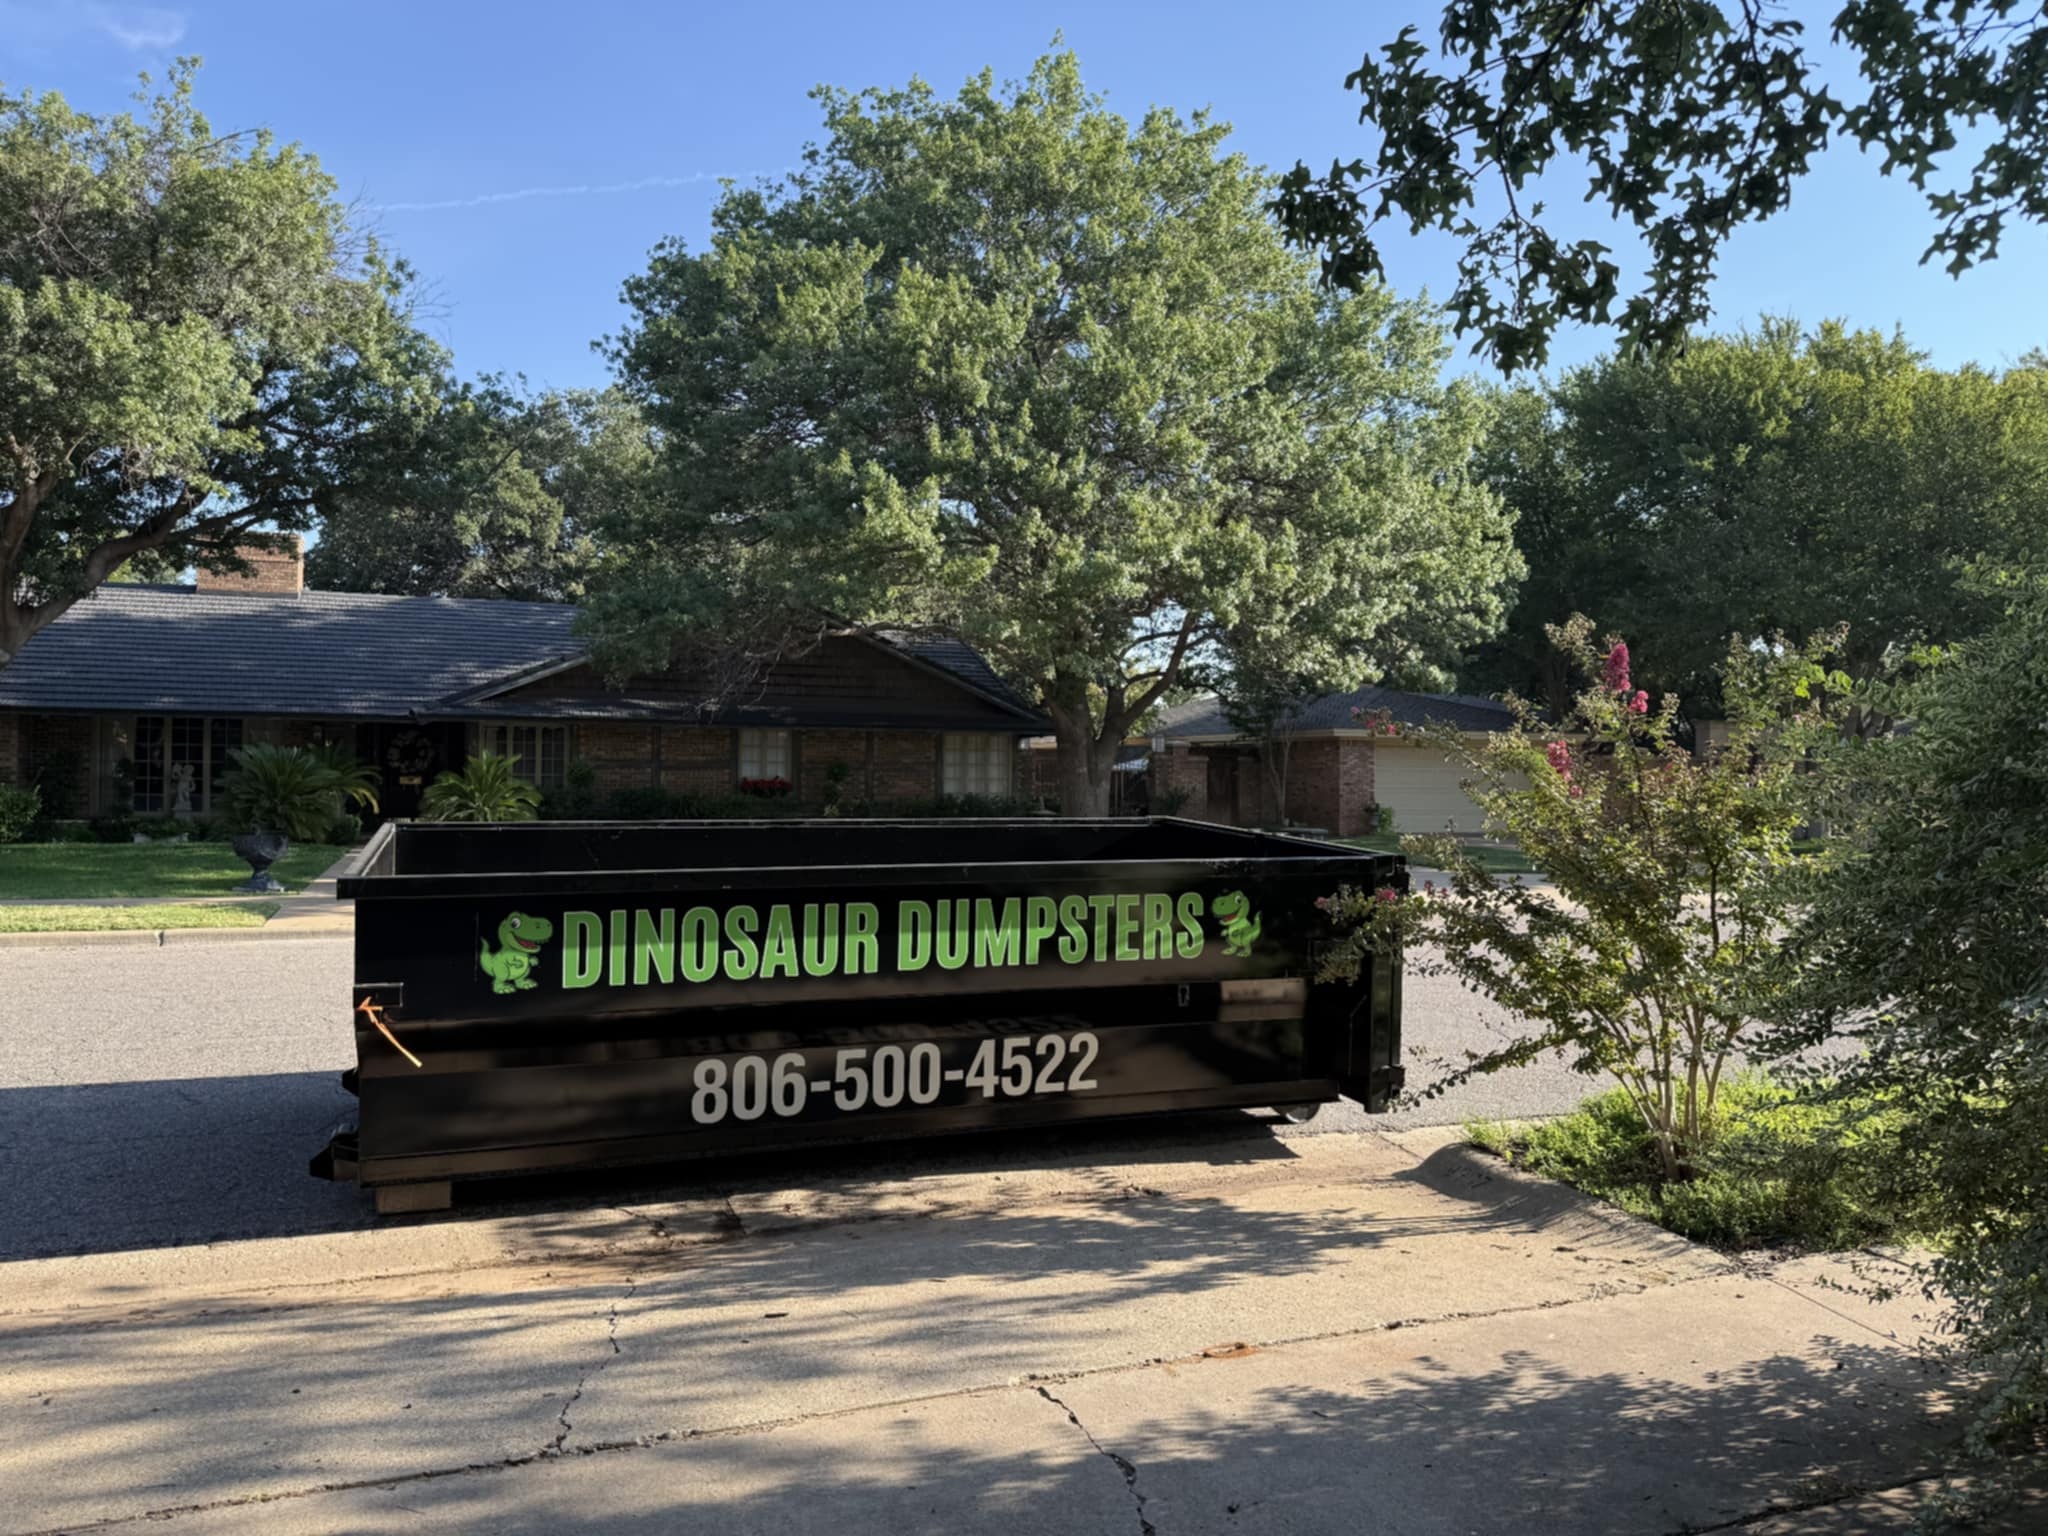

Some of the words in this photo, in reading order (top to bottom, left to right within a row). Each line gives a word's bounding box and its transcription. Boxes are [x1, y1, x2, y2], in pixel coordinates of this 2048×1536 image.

[562, 902, 880, 989] DINOSAUR
[897, 891, 1205, 972] DUMPSTERS
[691, 1032, 1099, 1124] 806-500-4522
